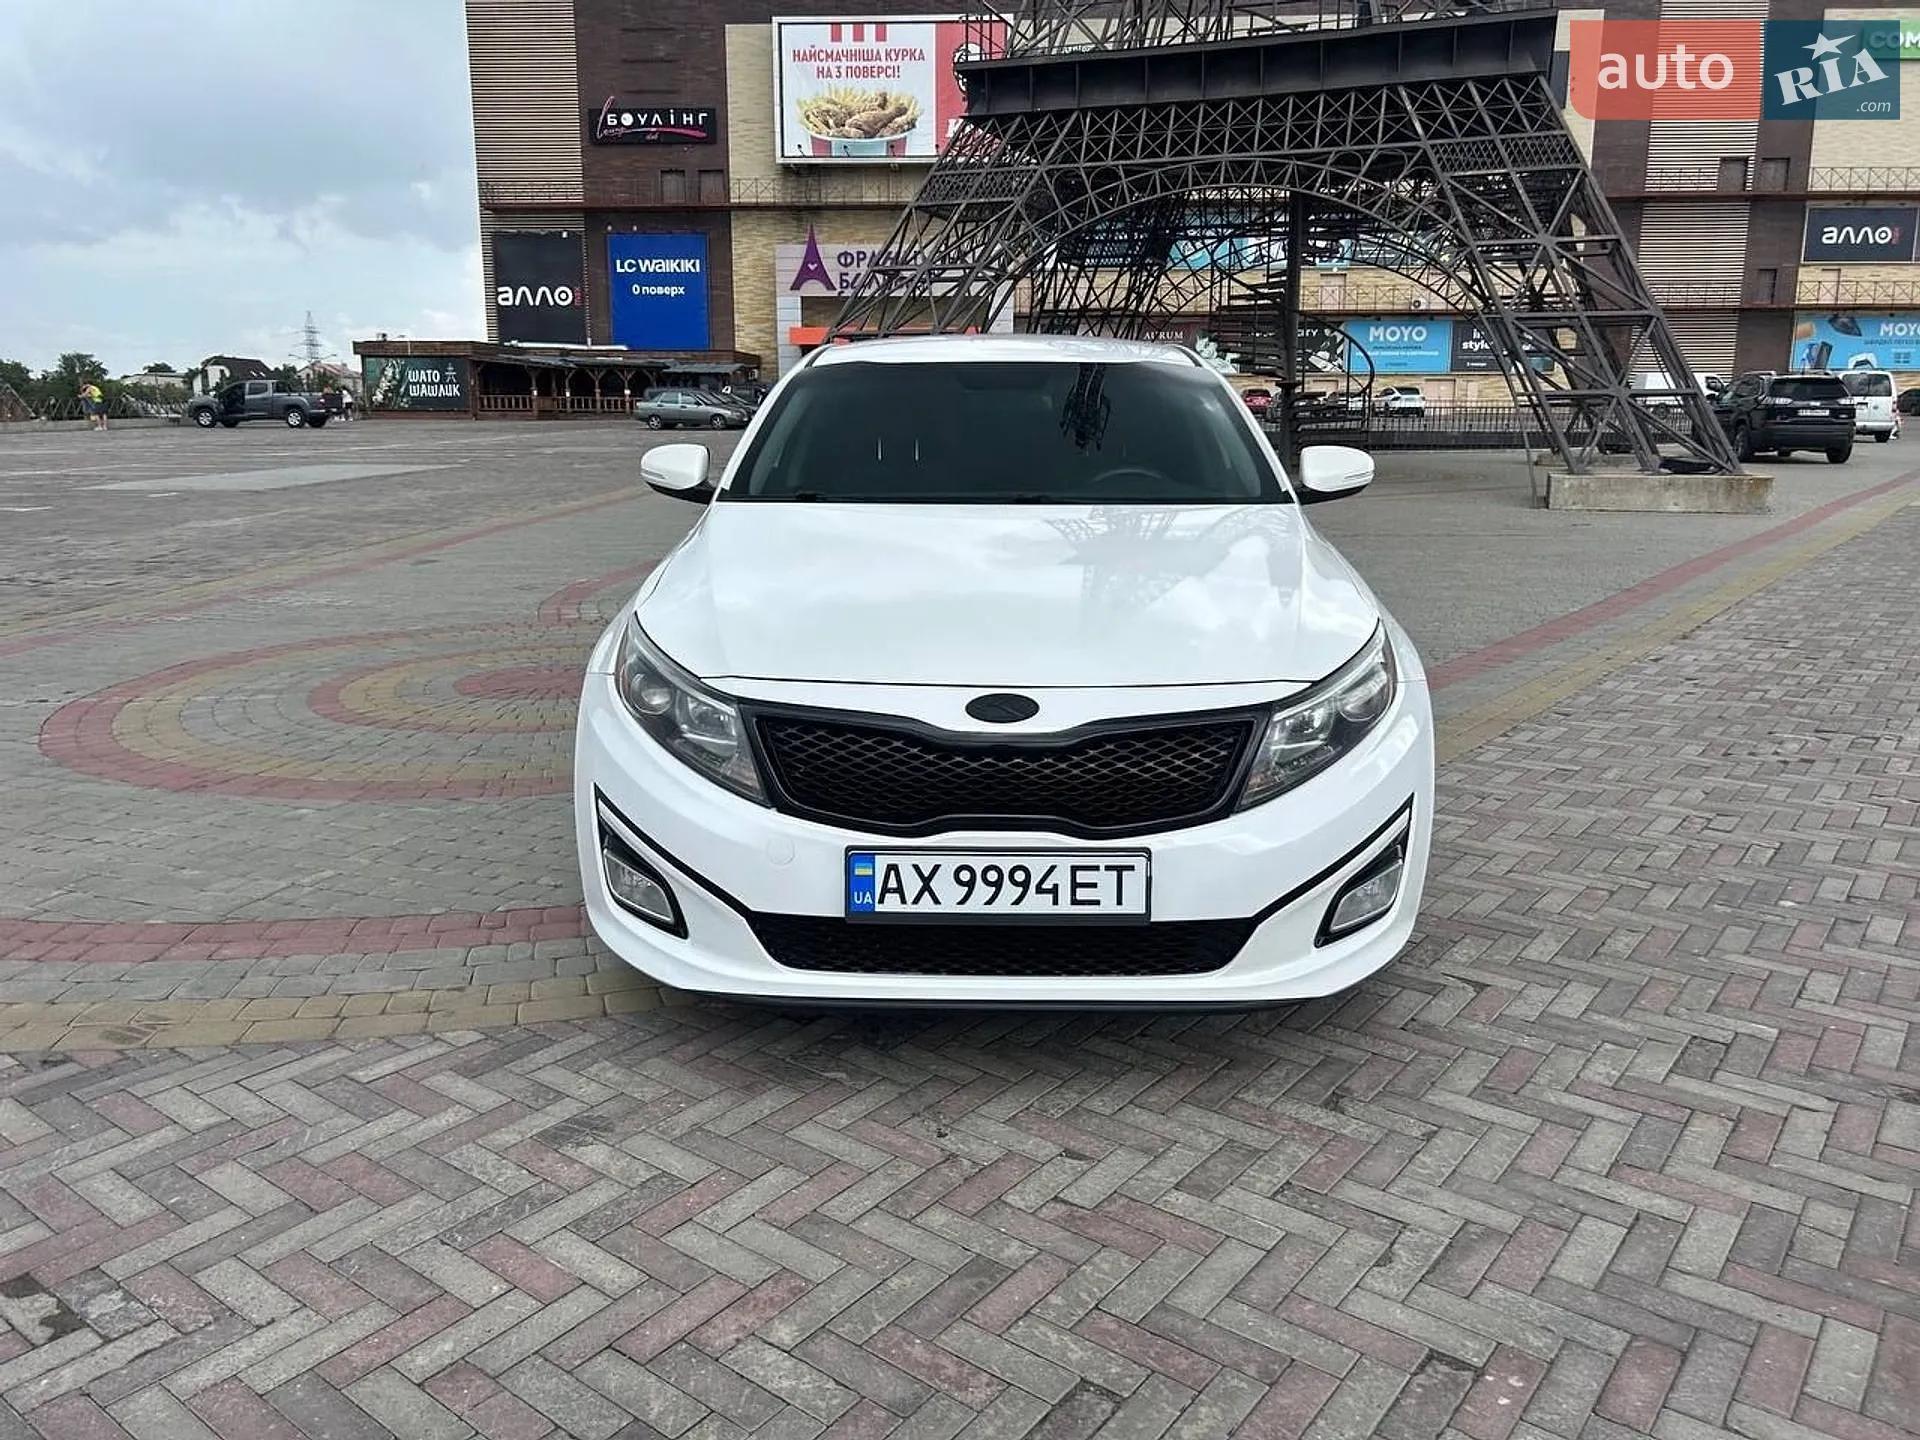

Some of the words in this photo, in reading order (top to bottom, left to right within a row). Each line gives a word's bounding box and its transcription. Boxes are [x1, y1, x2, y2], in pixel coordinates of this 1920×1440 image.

[792, 45, 882, 62] НАЙСМАЧНІША
[885, 48, 926, 61] КУРКА
[816, 66, 833, 79] НА
[835, 65, 842, 79] 3
[845, 65, 900, 79] ПОВЕРСІ!
[607, 109, 708, 126] БОУЛІНГ
[616, 259, 637, 273] LC
[642, 286, 685, 297] поверх
[1369, 326, 1427, 342] MOYO
[408, 369, 440, 382] ШАТО
[410, 384, 460, 397] ШАШЛИК
[877, 863, 942, 905] AX
[854, 891, 874, 905] UA
